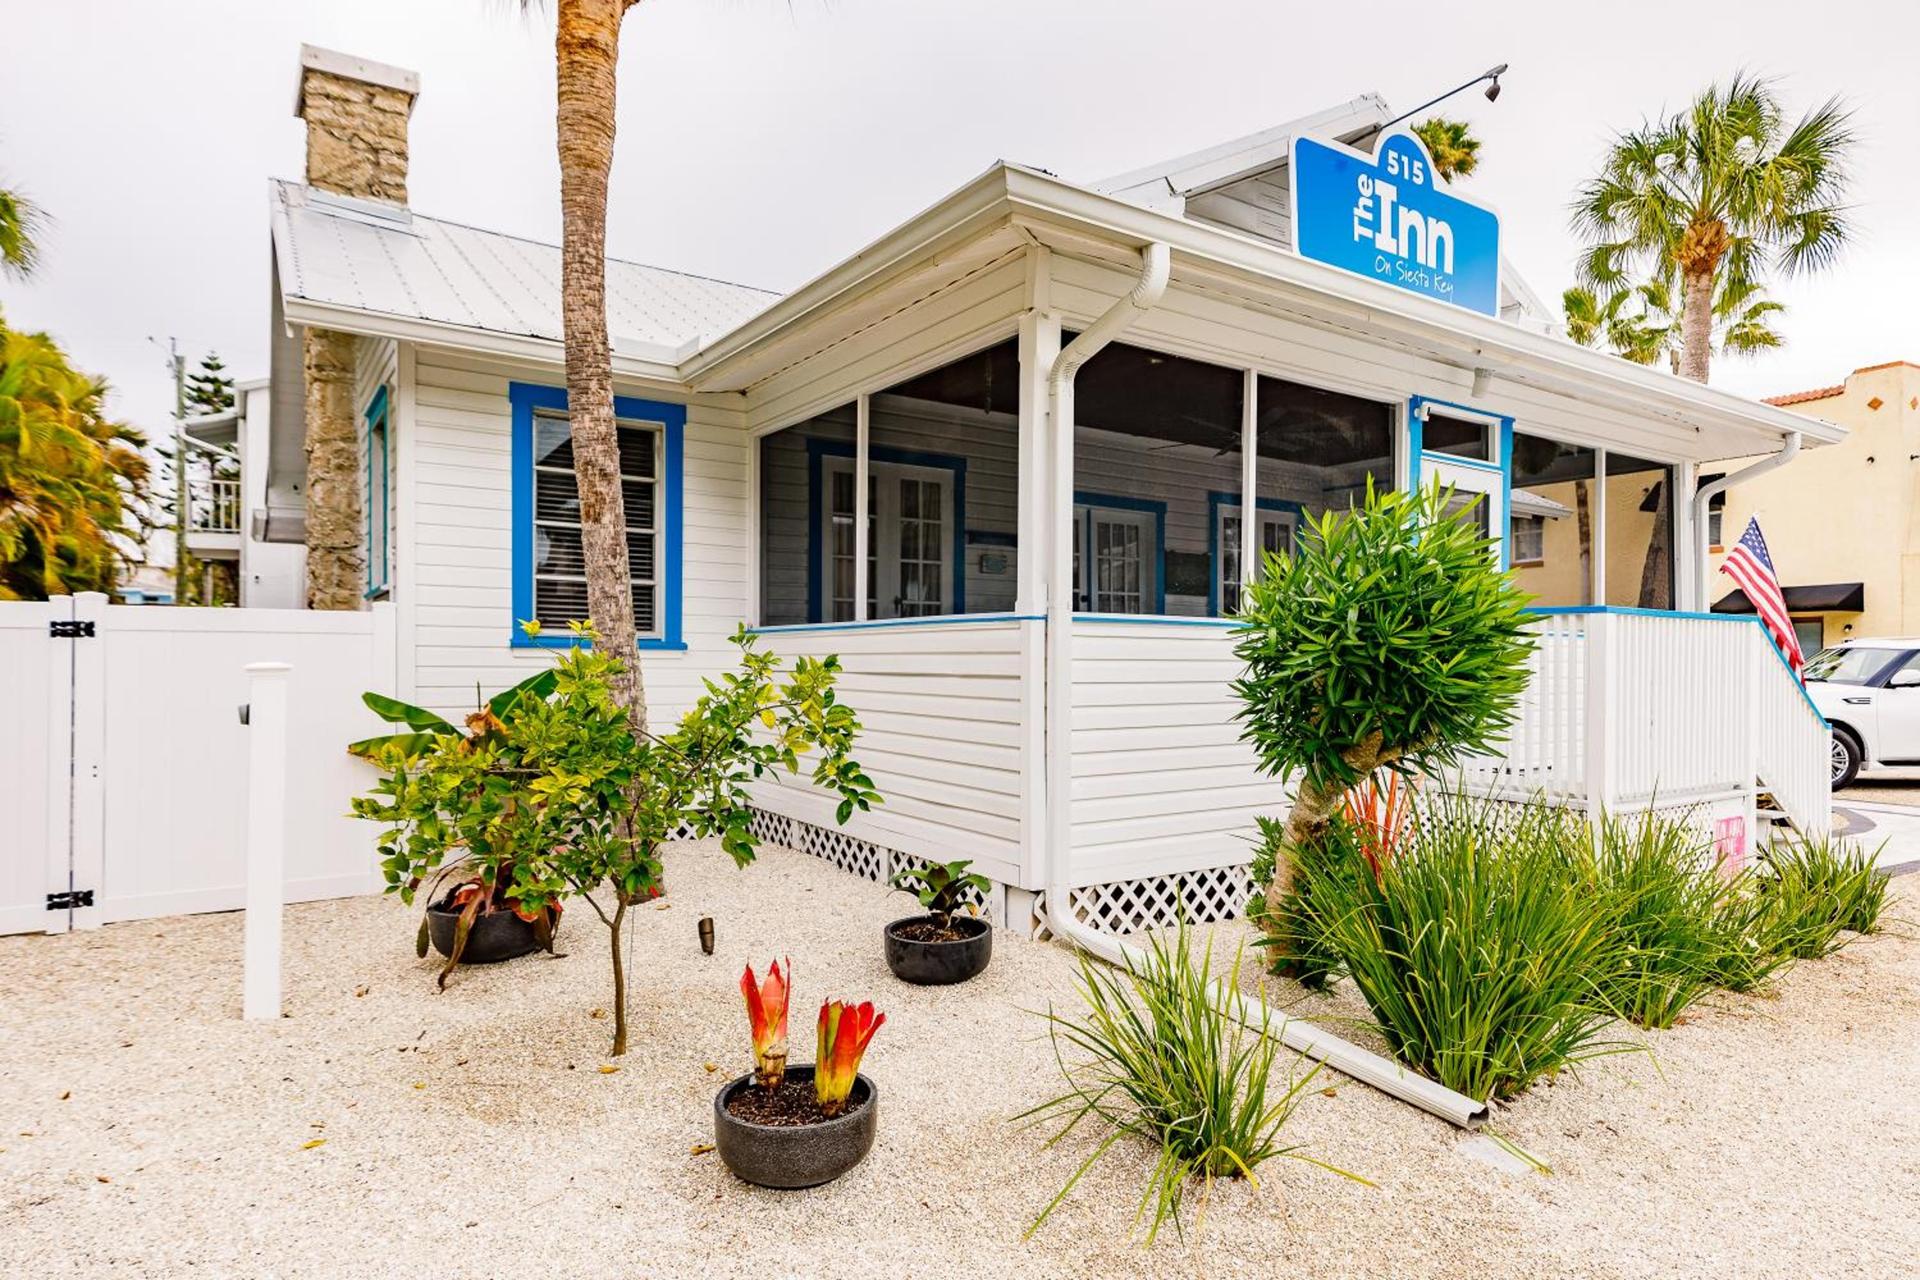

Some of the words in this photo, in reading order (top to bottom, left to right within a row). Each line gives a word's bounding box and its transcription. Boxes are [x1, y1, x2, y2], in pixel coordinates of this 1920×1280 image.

[1387, 149, 1424, 185] 515
[1353, 173, 1374, 242] The
[1374, 178, 1454, 275] Inn
[1375, 254, 1392, 277] On
[1395, 260, 1430, 288] Siesta
[1434, 273, 1454, 303] Key
